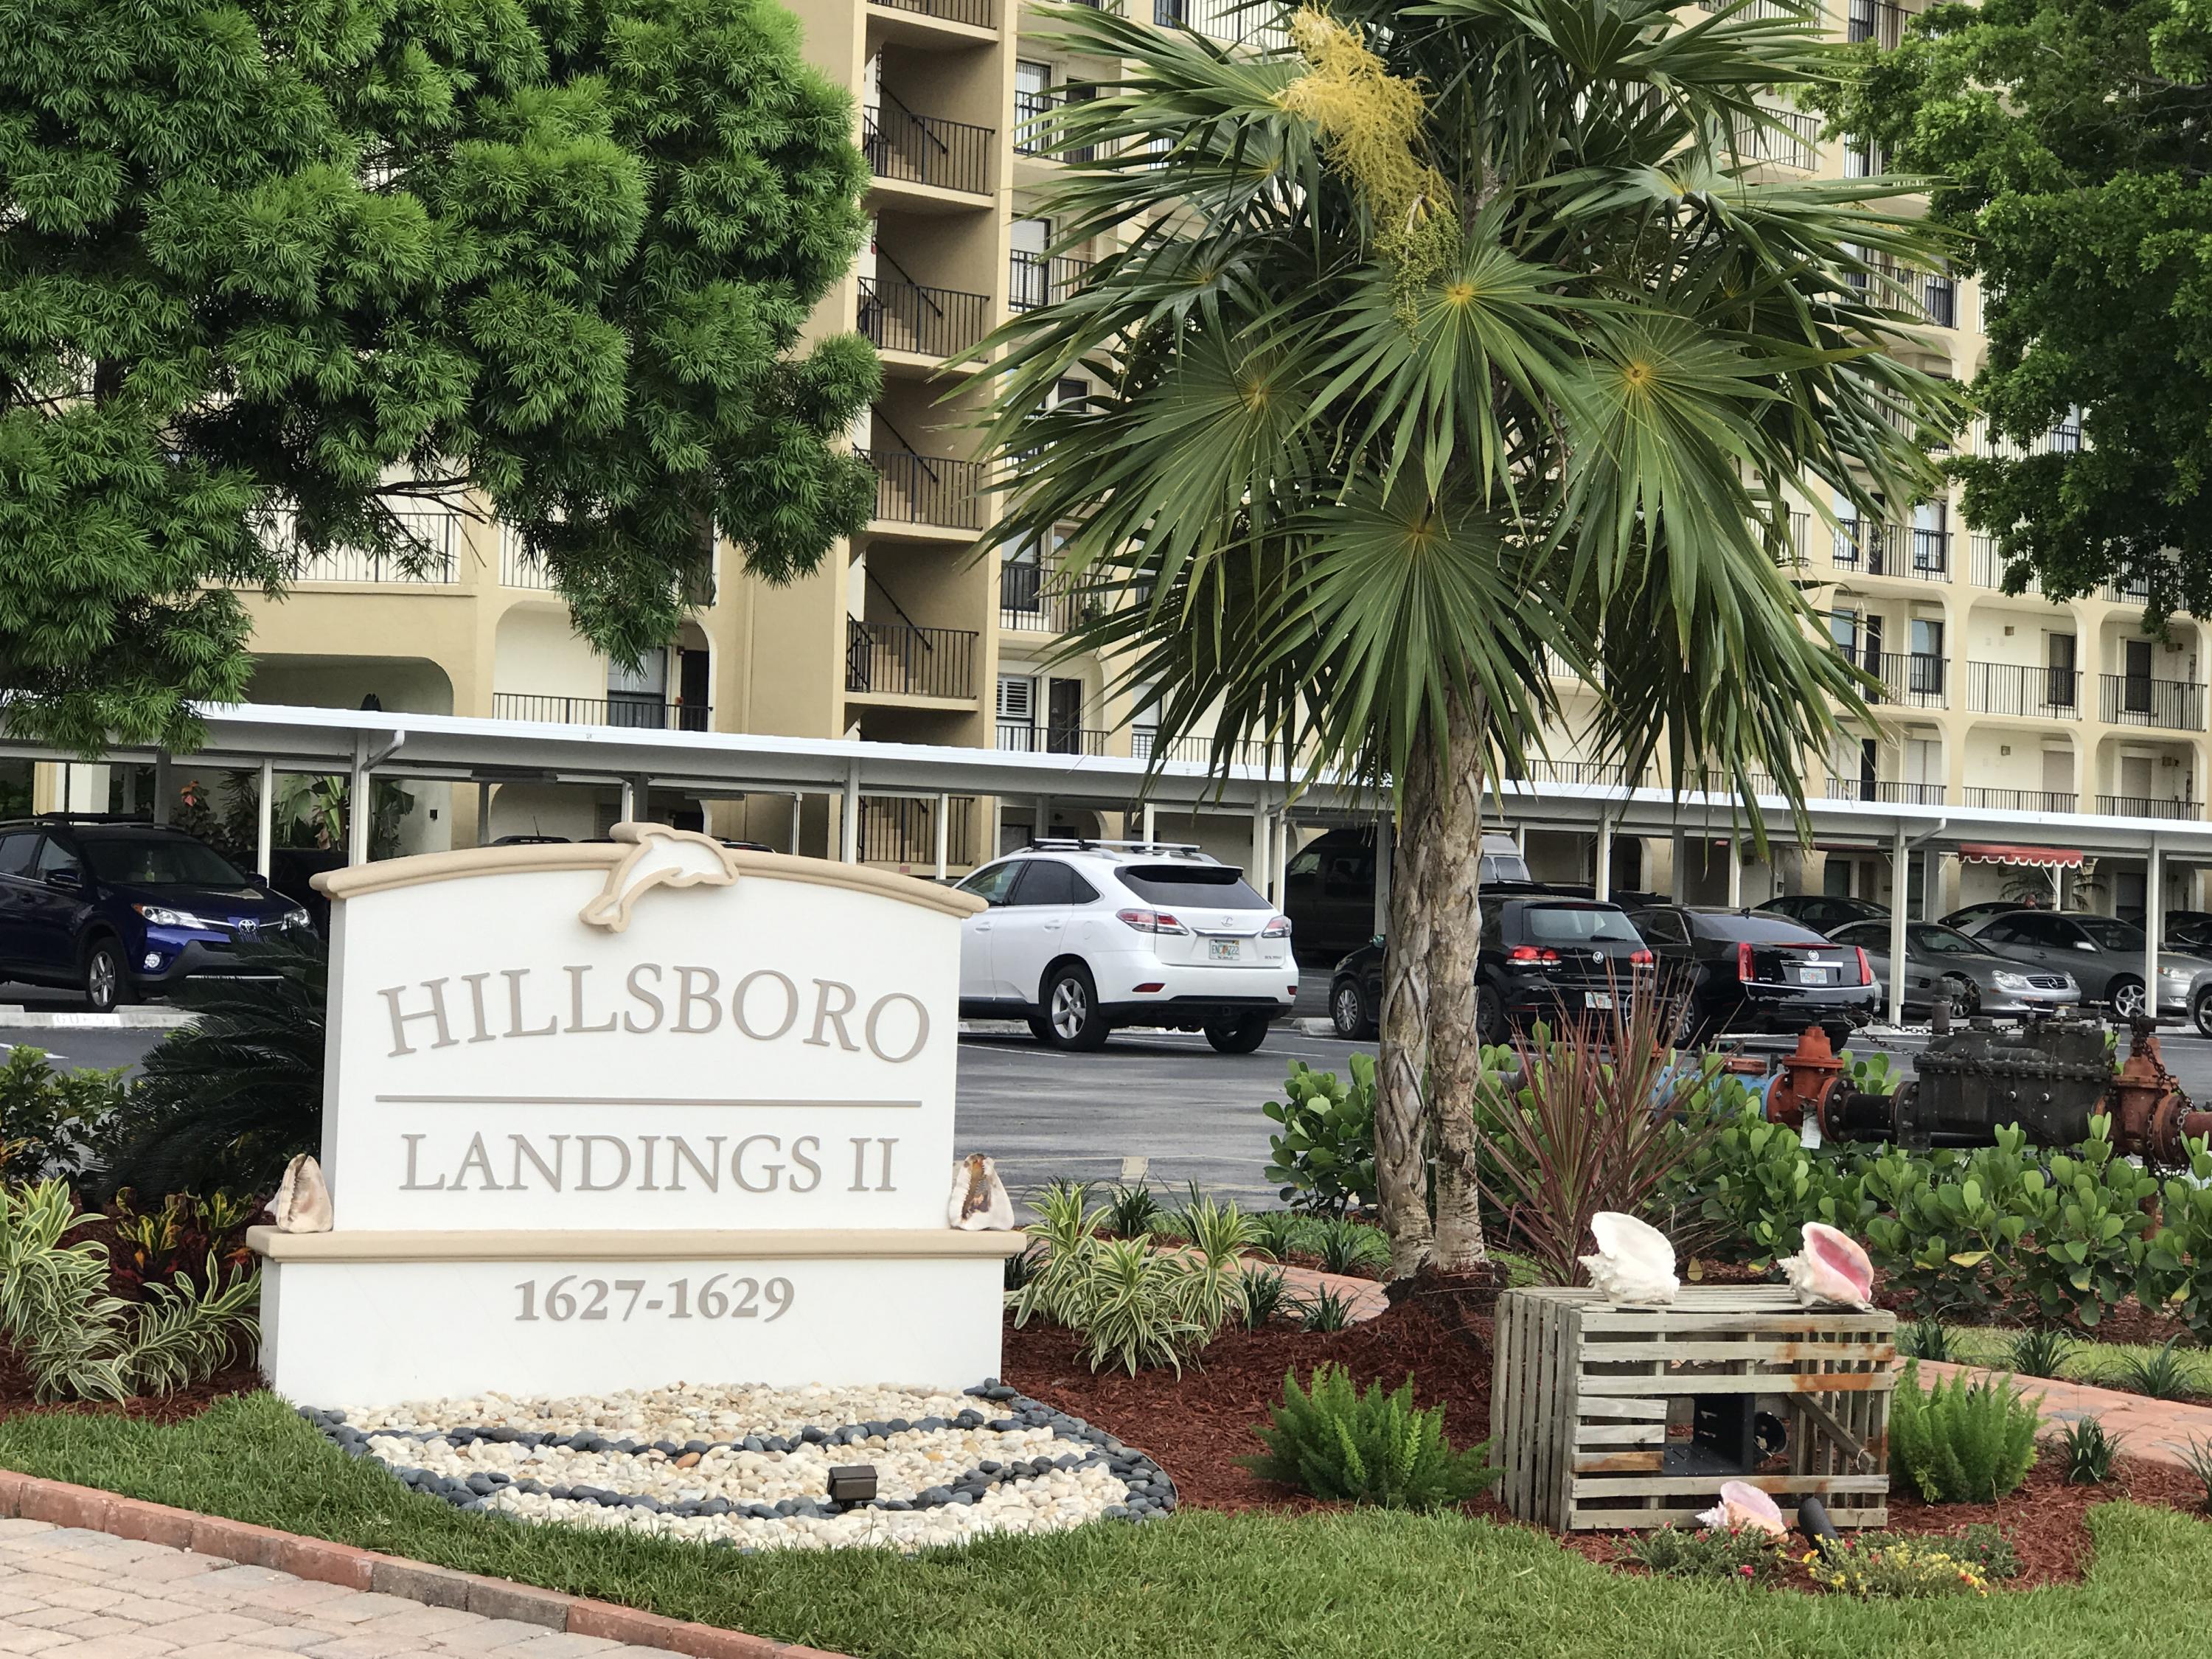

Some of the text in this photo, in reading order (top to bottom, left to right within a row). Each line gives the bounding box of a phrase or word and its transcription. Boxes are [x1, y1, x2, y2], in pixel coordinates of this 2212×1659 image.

[377, 962, 930, 1063] HILLSBORO
[399, 1131, 900, 1193] LANDINGS II
[514, 1273, 795, 1322] 1627-1629
